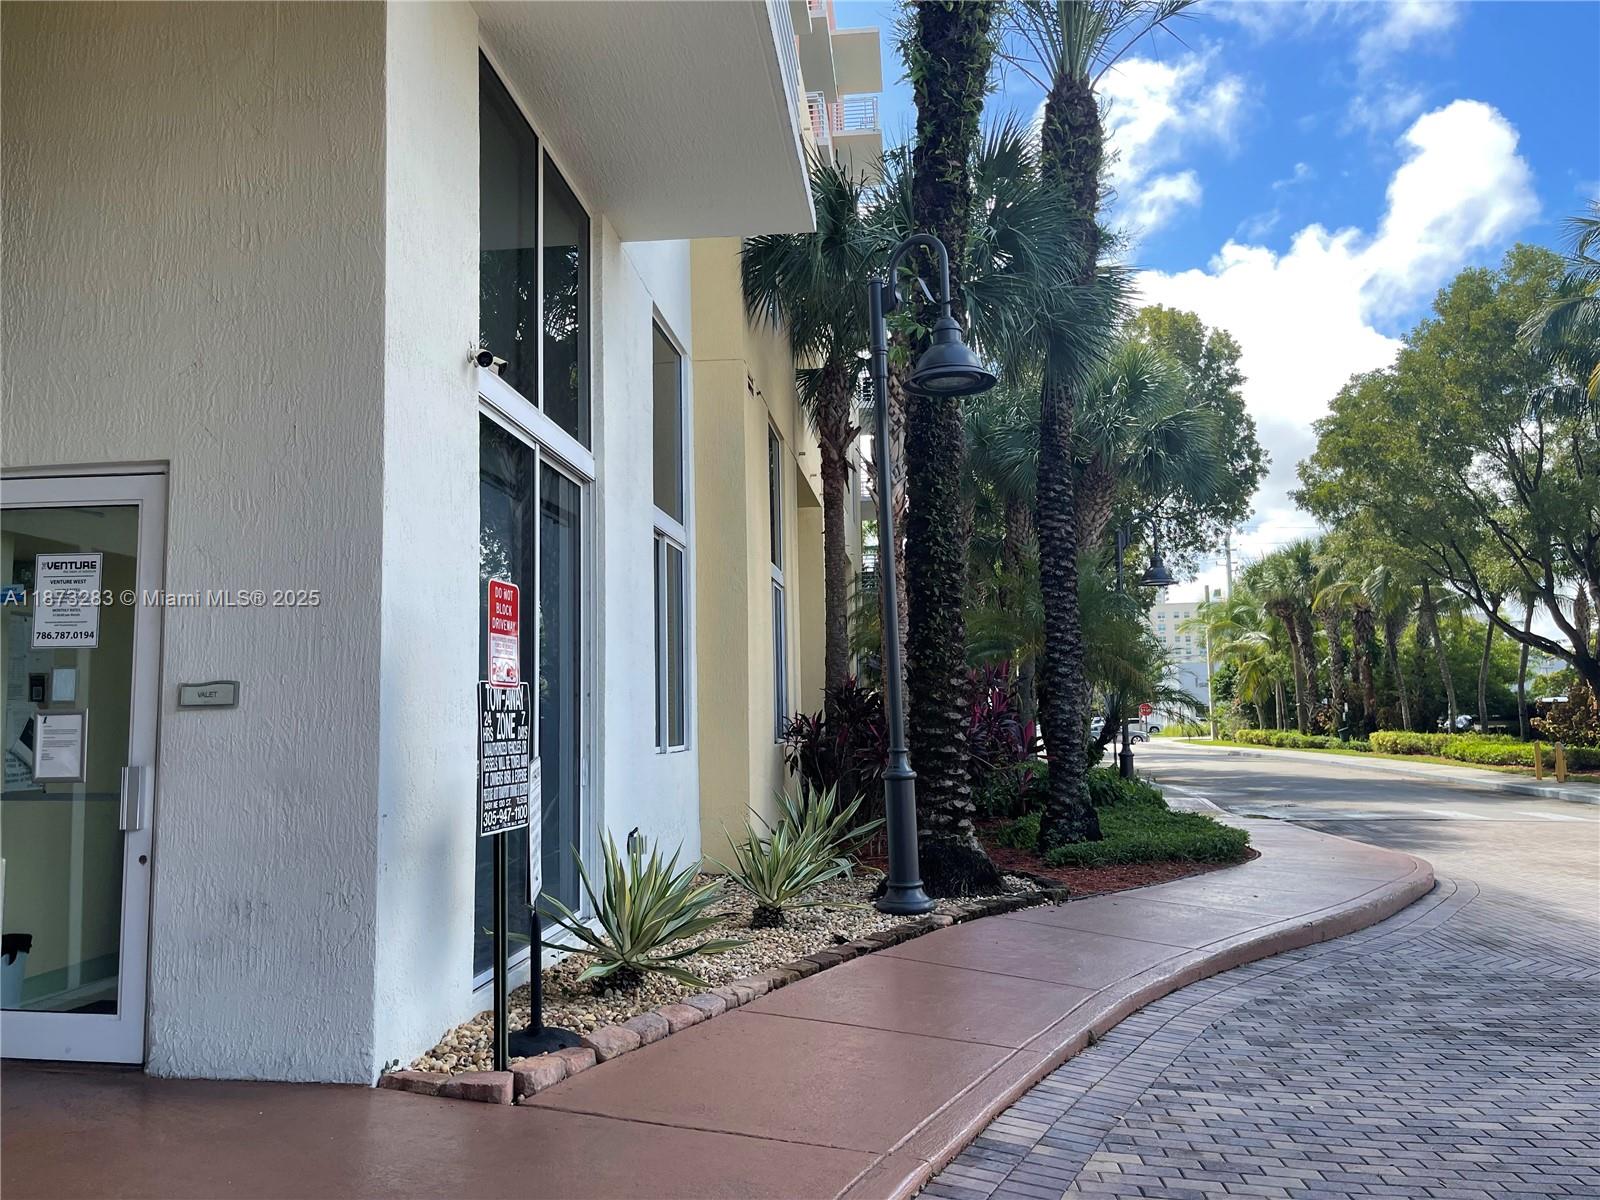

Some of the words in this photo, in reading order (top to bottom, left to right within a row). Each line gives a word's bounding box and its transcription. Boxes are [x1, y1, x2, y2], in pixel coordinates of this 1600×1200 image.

[47, 561, 97, 570] VENTURE
[495, 586, 502, 599] DO
[503, 588, 513, 601] NOT
[495, 602, 513, 616] BLOCK
[492, 616, 517, 632] DRIVEWAY
[36, 631, 95, 640] 786.787.0194
[485, 684, 524, 711] TOW-AWAY
[483, 711, 492, 727] 24
[521, 711, 526, 725] 7
[483, 726, 494, 741] HRS
[496, 712, 516, 740] ZONE
[517, 725, 528, 740] DAYS
[483, 804, 528, 827] 305-947-1100
